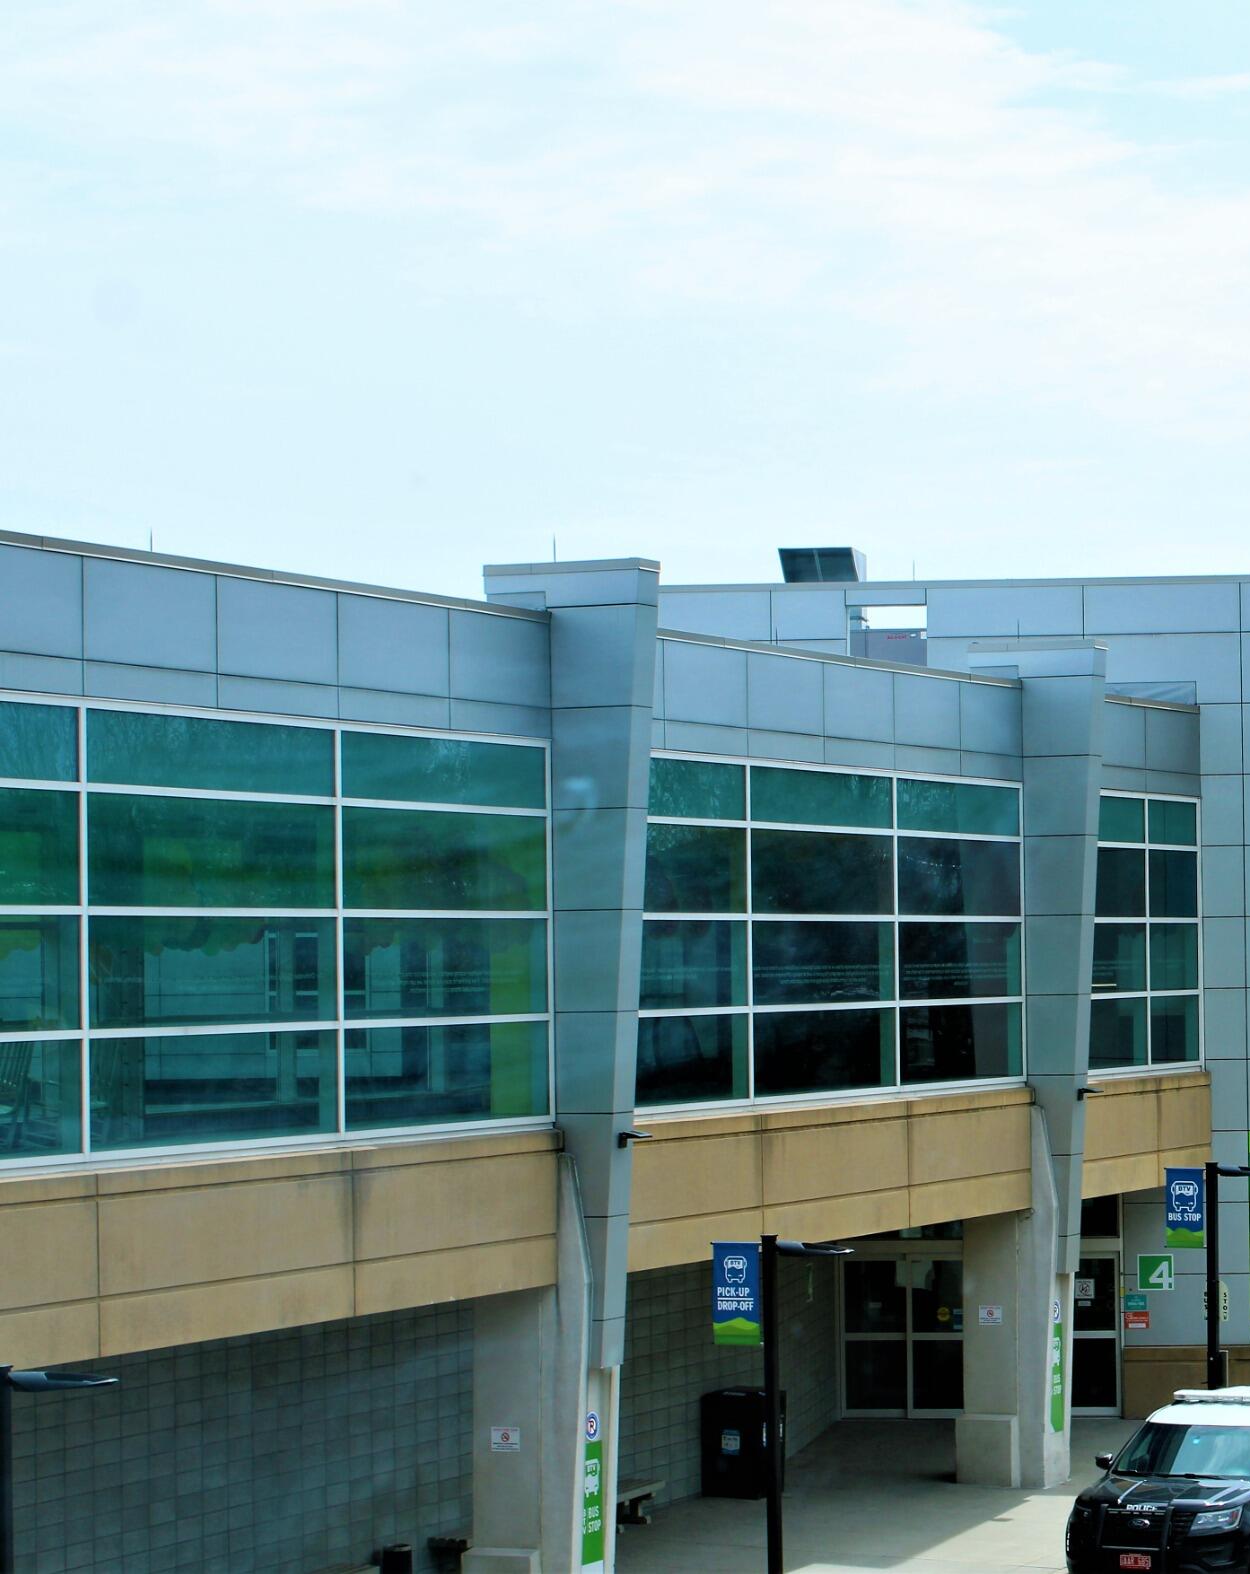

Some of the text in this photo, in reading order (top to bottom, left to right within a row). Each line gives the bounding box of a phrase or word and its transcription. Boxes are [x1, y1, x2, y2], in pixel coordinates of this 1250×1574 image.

[1168, 1213, 1202, 1221] BUS STOP
[1149, 1261, 1174, 1290] 4
[717, 1287, 750, 1297] PICK-UP
[717, 1301, 754, 1311] DROP-OFF
[588, 1506, 599, 1519] BUS
[588, 1519, 601, 1534] STOP
